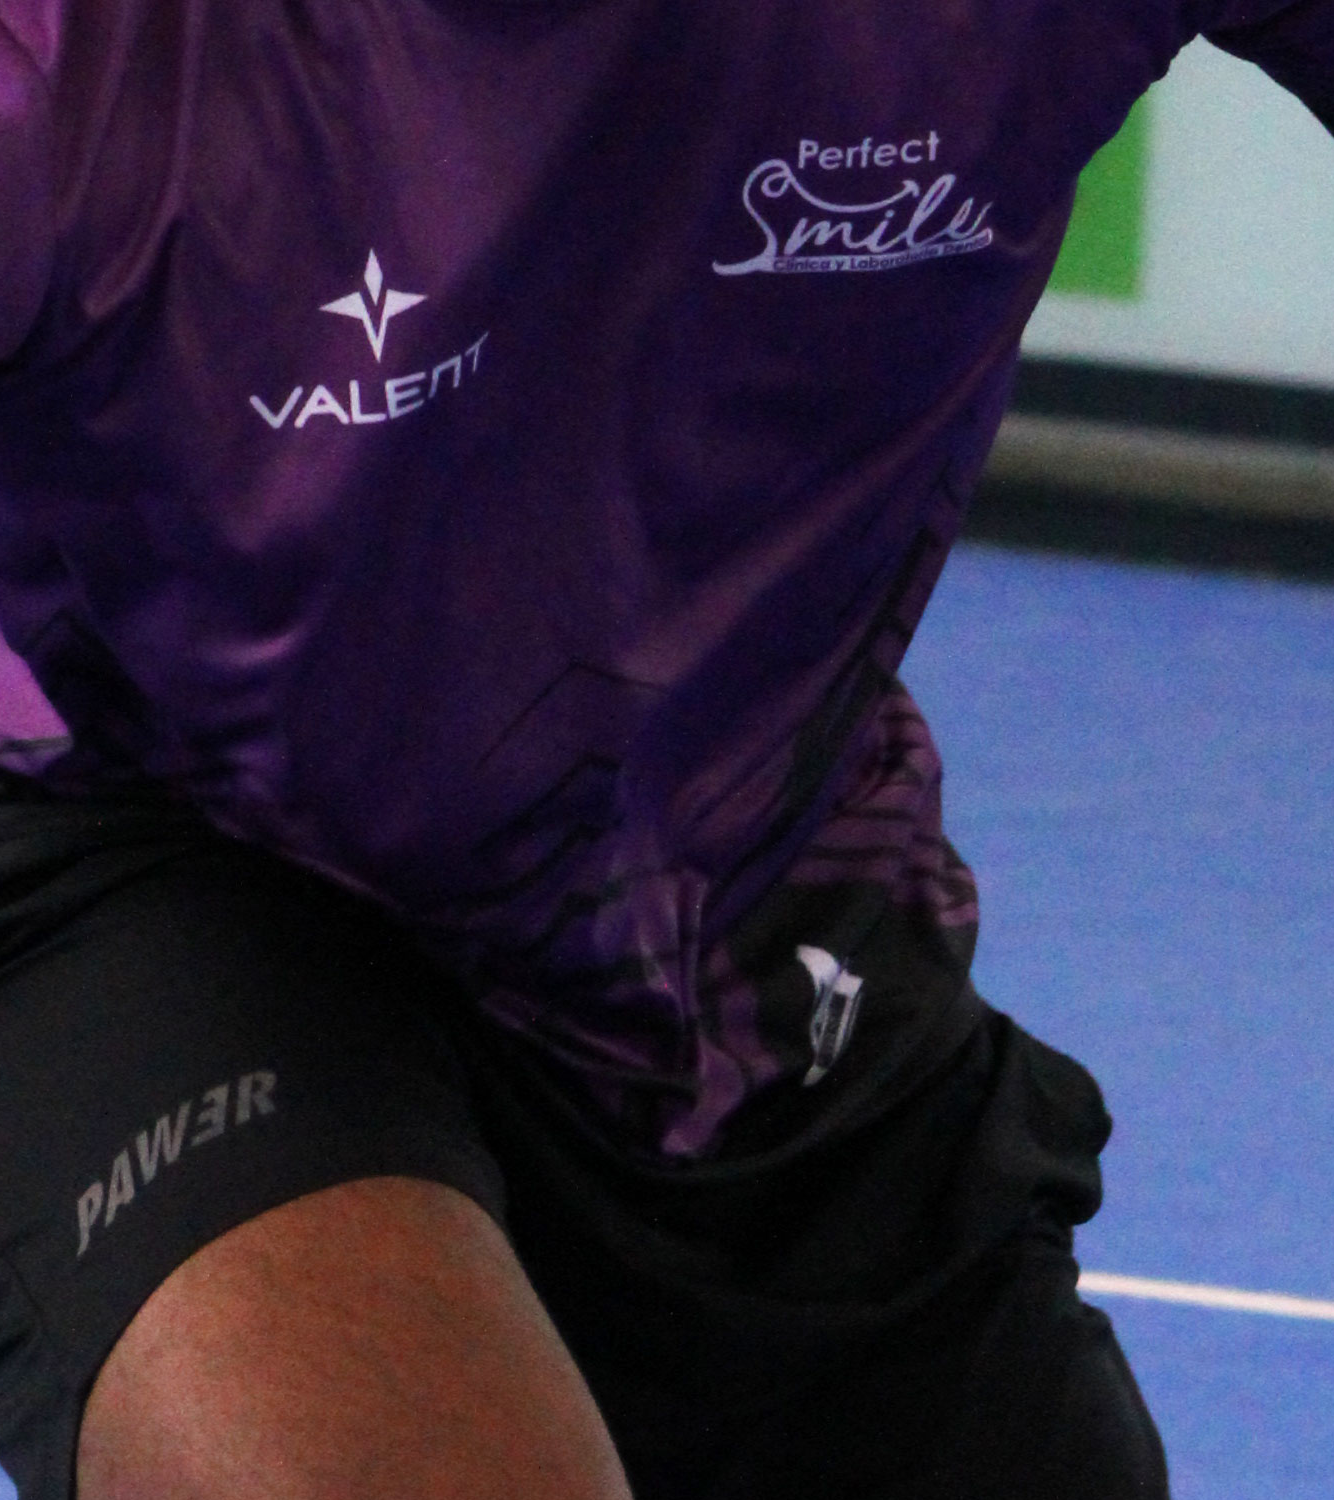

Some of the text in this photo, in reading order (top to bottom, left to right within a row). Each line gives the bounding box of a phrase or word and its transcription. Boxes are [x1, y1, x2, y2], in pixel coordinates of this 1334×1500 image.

[798, 131, 939, 170] Perfect
[712, 158, 994, 276] Smile
[249, 331, 490, 430] VALENT
